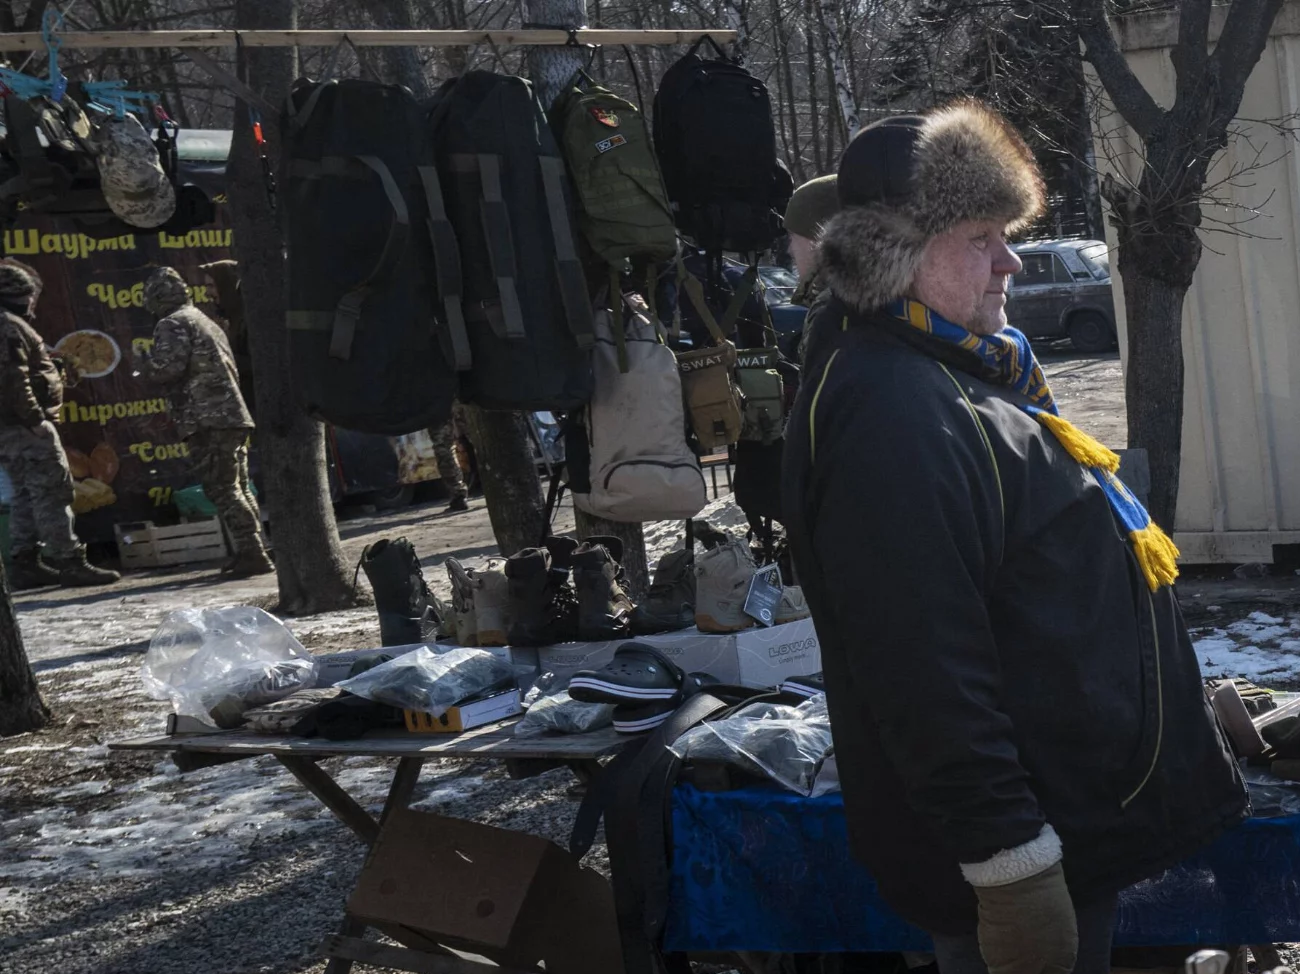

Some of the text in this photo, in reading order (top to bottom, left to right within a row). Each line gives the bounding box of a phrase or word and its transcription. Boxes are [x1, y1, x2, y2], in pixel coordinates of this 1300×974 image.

[3, 229, 136, 259] Шаурма
[681, 355, 723, 372] SWAT
[738, 355, 769, 367] WAT
[768, 637, 817, 658] LOWA
